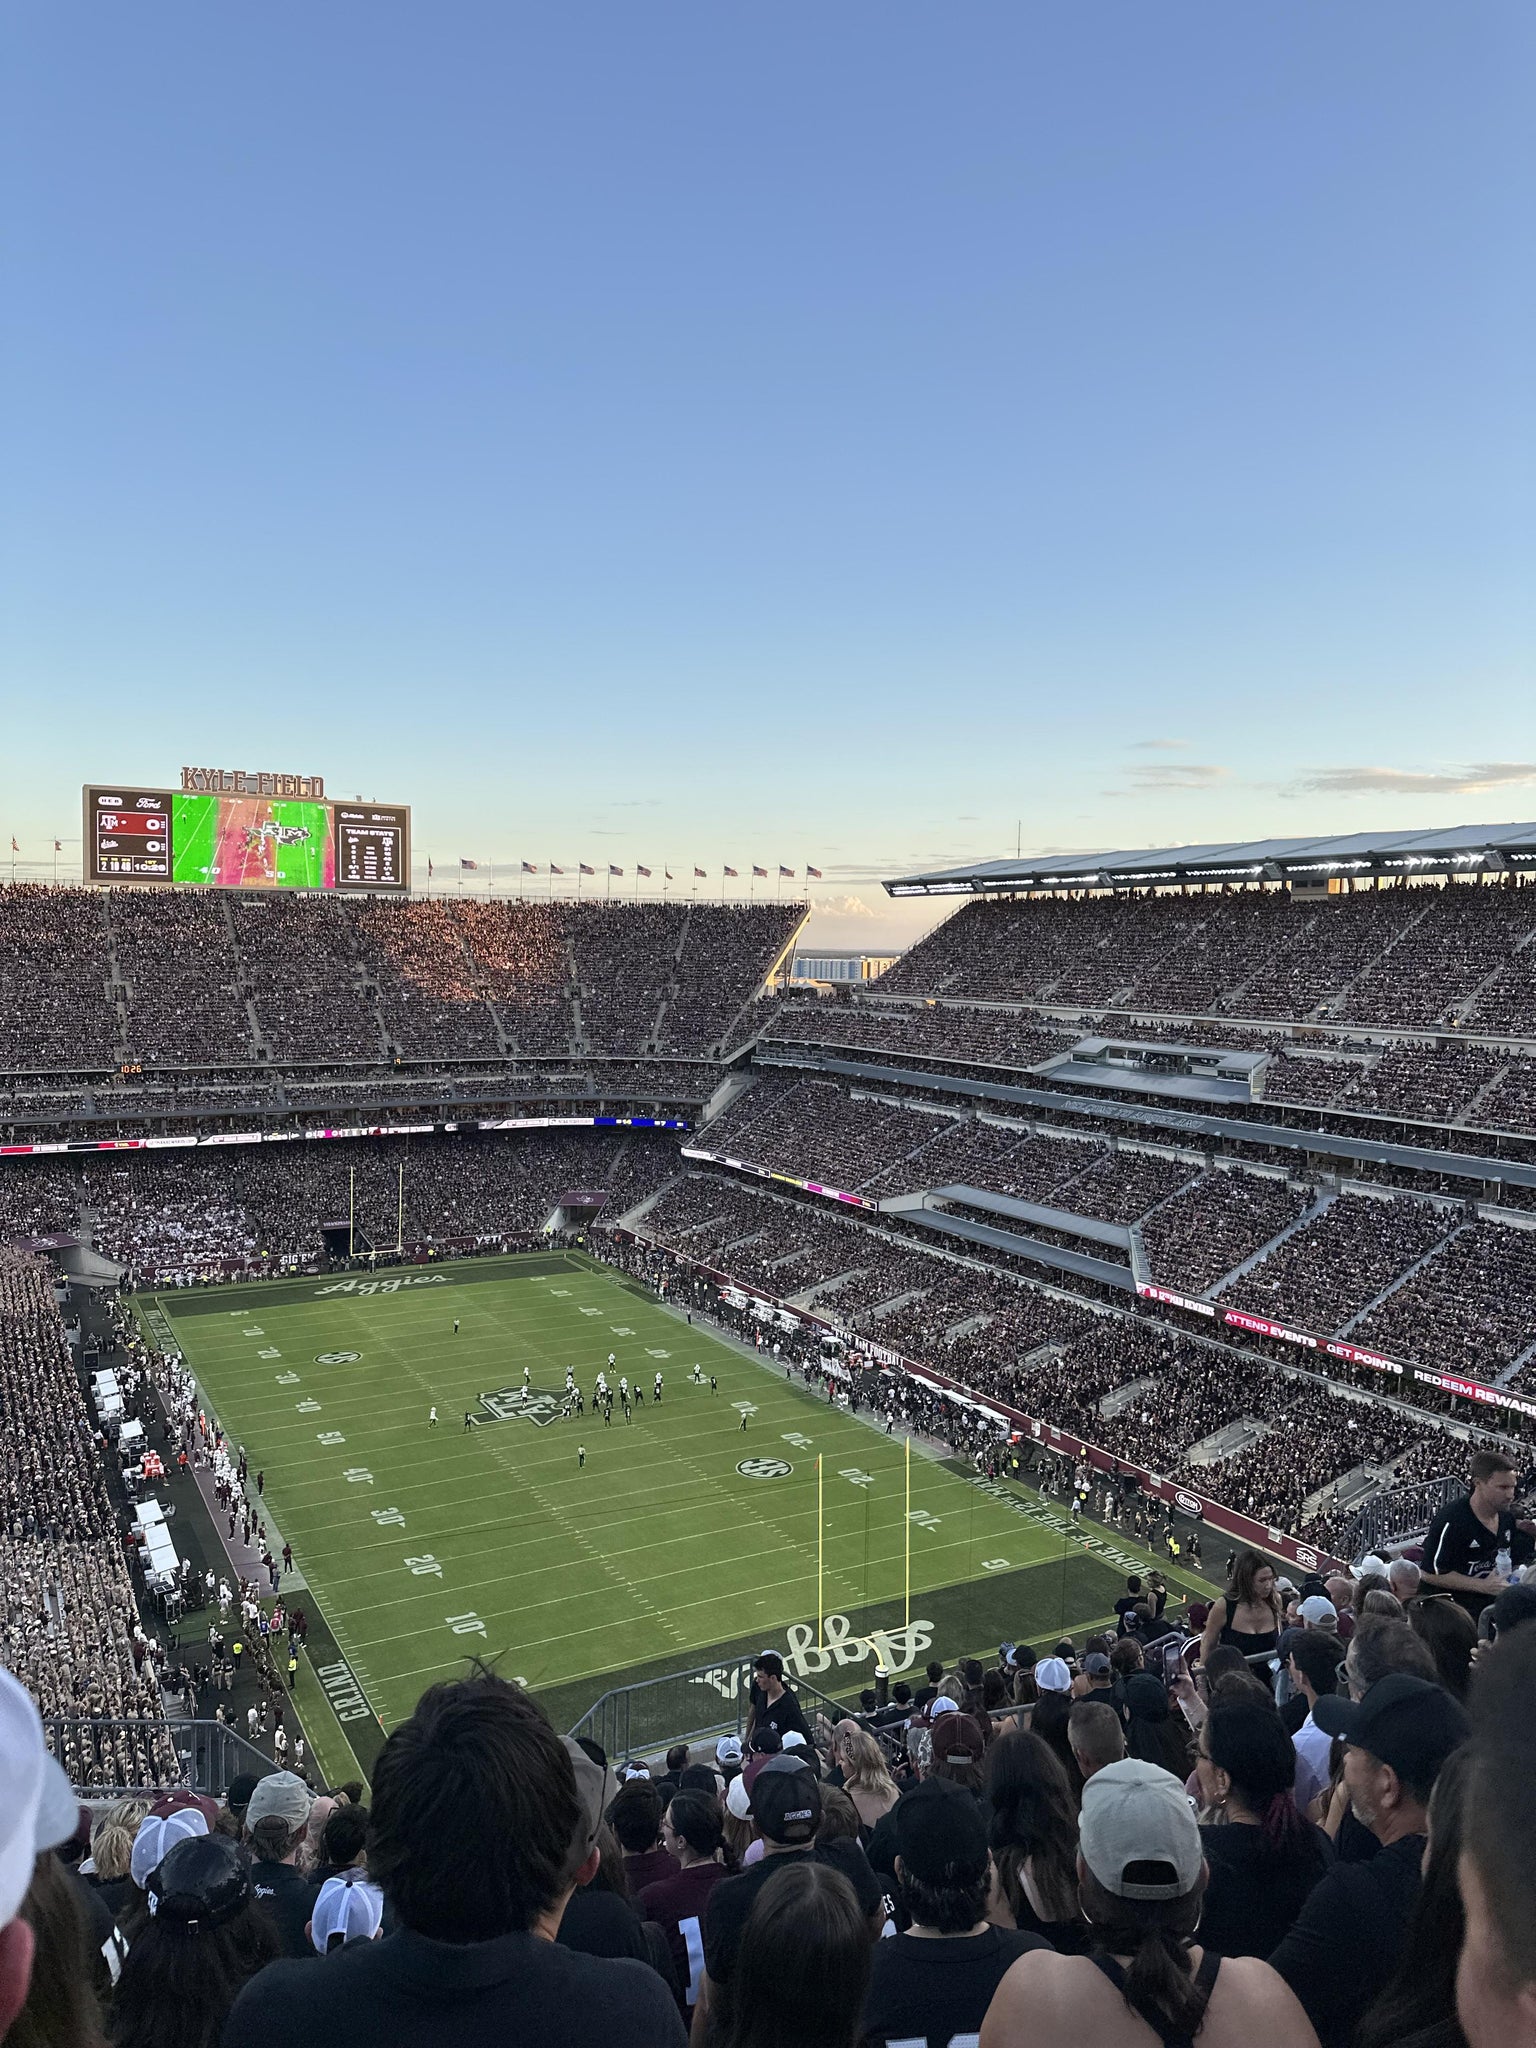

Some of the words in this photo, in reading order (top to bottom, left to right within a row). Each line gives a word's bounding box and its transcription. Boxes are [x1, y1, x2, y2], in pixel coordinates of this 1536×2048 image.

[181, 766, 247, 792] KYLE
[256, 772, 325, 798] FIELD
[136, 797, 162, 809] Ford
[146, 819, 160, 830] 0
[146, 841, 160, 852] 0
[101, 862, 107, 871] 2
[314, 1274, 454, 1296] Aggies
[1224, 1312, 1269, 1333] ATTEND
[1269, 1326, 1318, 1348] EVENTS
[870, 1344, 904, 1370] FOOTBALL
[1326, 1343, 1352, 1358] GET
[1353, 1351, 1404, 1374] POINTS
[1413, 1369, 1473, 1396] REDEEM
[316, 1431, 346, 1446] 50
[780, 1432, 813, 1448] 30
[343, 1467, 373, 1484] 40
[837, 1468, 875, 1487] 20
[967, 1474, 1010, 1499] MAN
[1002, 1495, 1038, 1515] 12TH
[371, 1507, 405, 1526] 30
[904, 1510, 942, 1528] 10
[1033, 1512, 1077, 1534] THE
[1071, 1532, 1104, 1553] OF
[403, 1554, 442, 1576] 20
[981, 1557, 1011, 1570] G
[1100, 1546, 1158, 1579] HOME
[1296, 1550, 1318, 1567] SRS
[445, 1611, 486, 1635] 10
[784, 1810, 812, 1821] AGGIES
